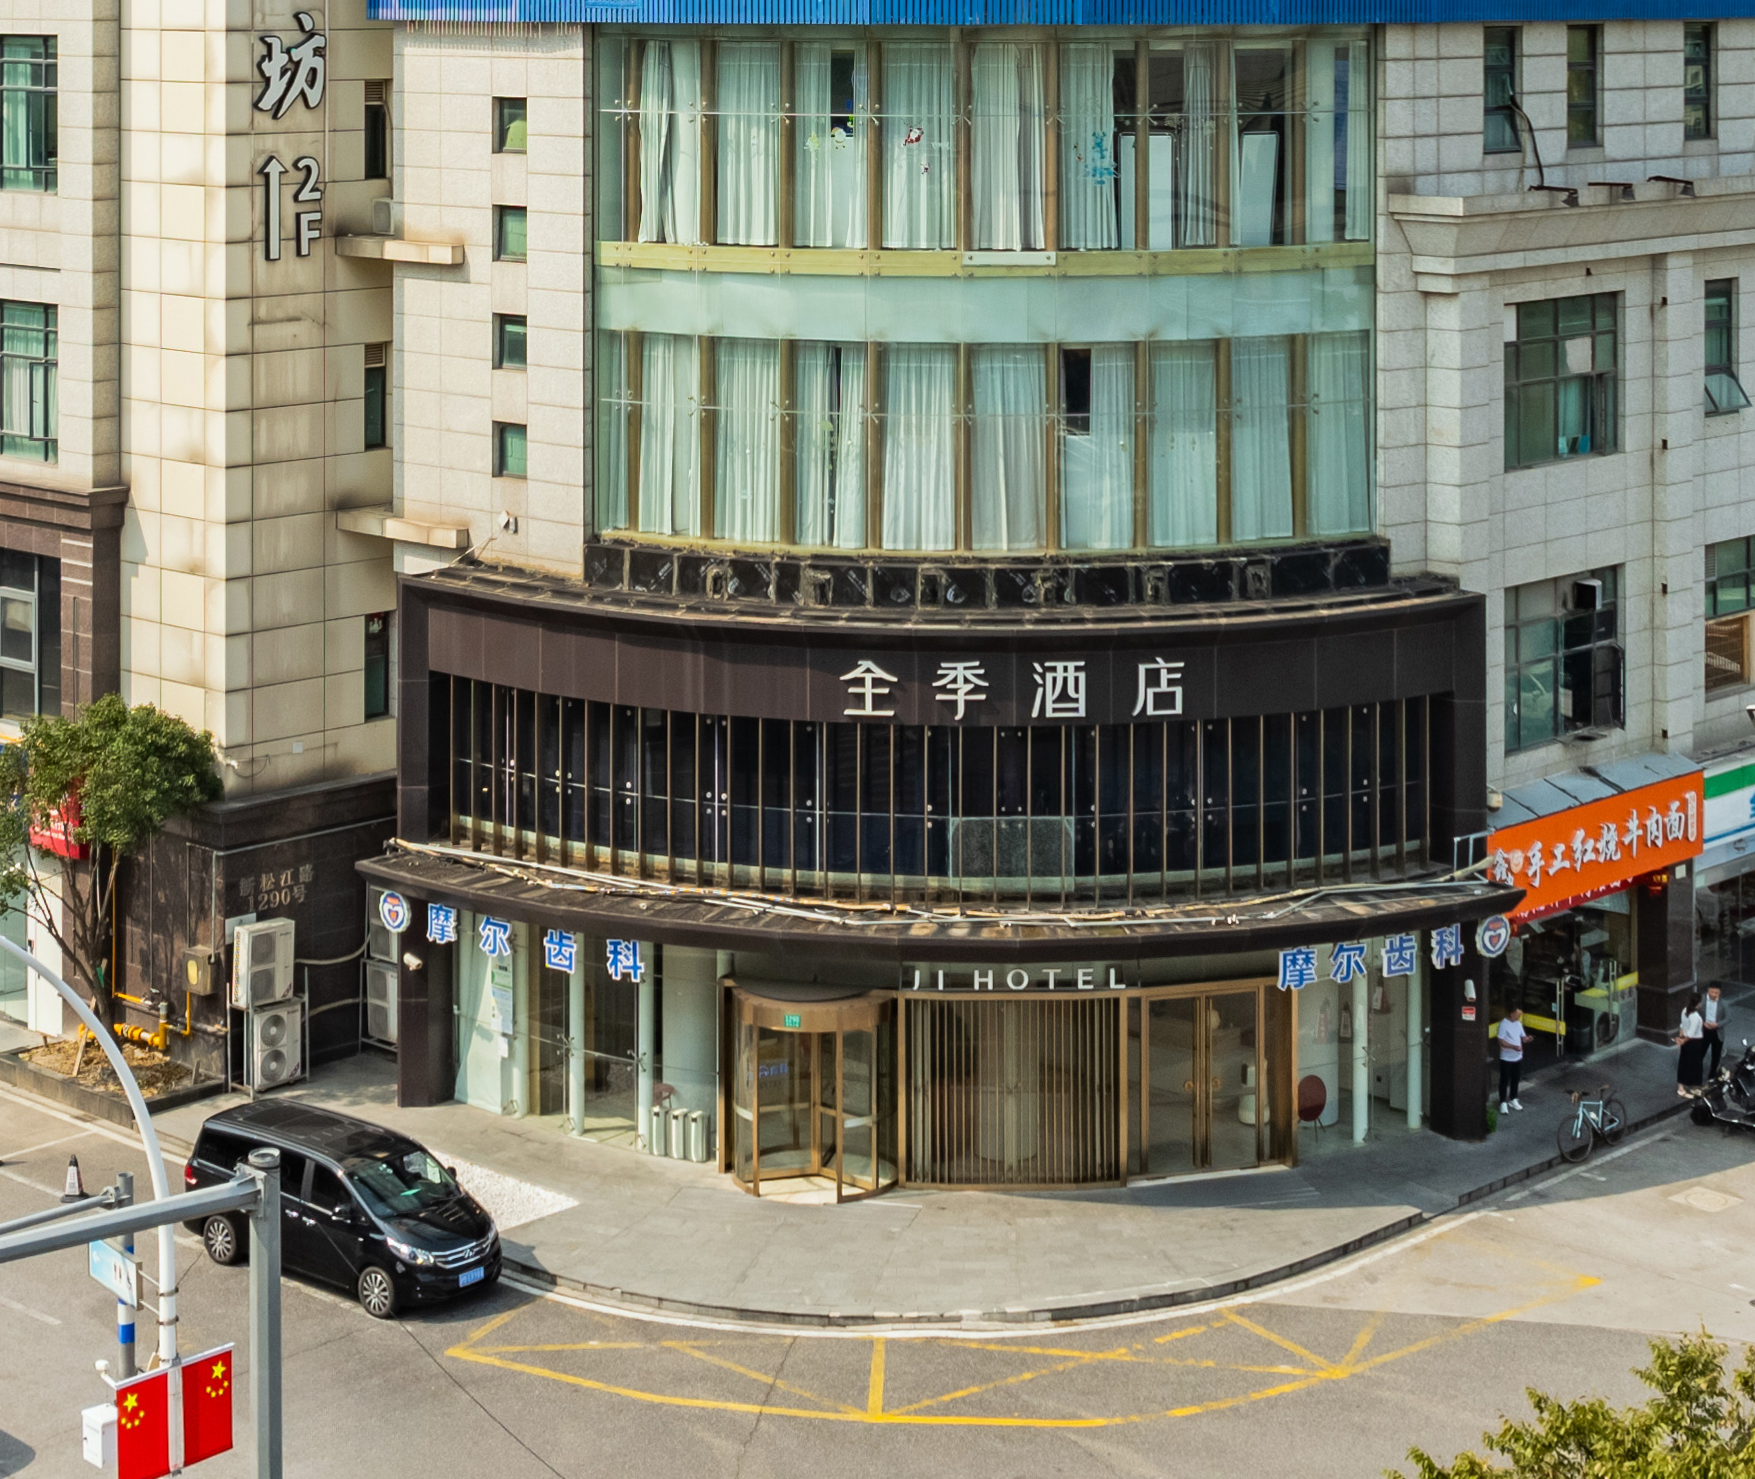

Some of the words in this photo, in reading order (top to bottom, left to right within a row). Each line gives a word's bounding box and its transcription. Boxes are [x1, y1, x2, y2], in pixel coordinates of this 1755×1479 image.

[840, 657, 1185, 720] 全季酒店
[1527, 800, 1685, 888] 手工红烧牛肉面
[239, 864, 314, 896] 新松江路
[248, 884, 306, 912] 1290号
[428, 901, 645, 983] 摩尔齿科
[1276, 923, 1463, 990] 摩尔齿科
[912, 970, 945, 989] JI
[974, 966, 1126, 990] HOTEL
